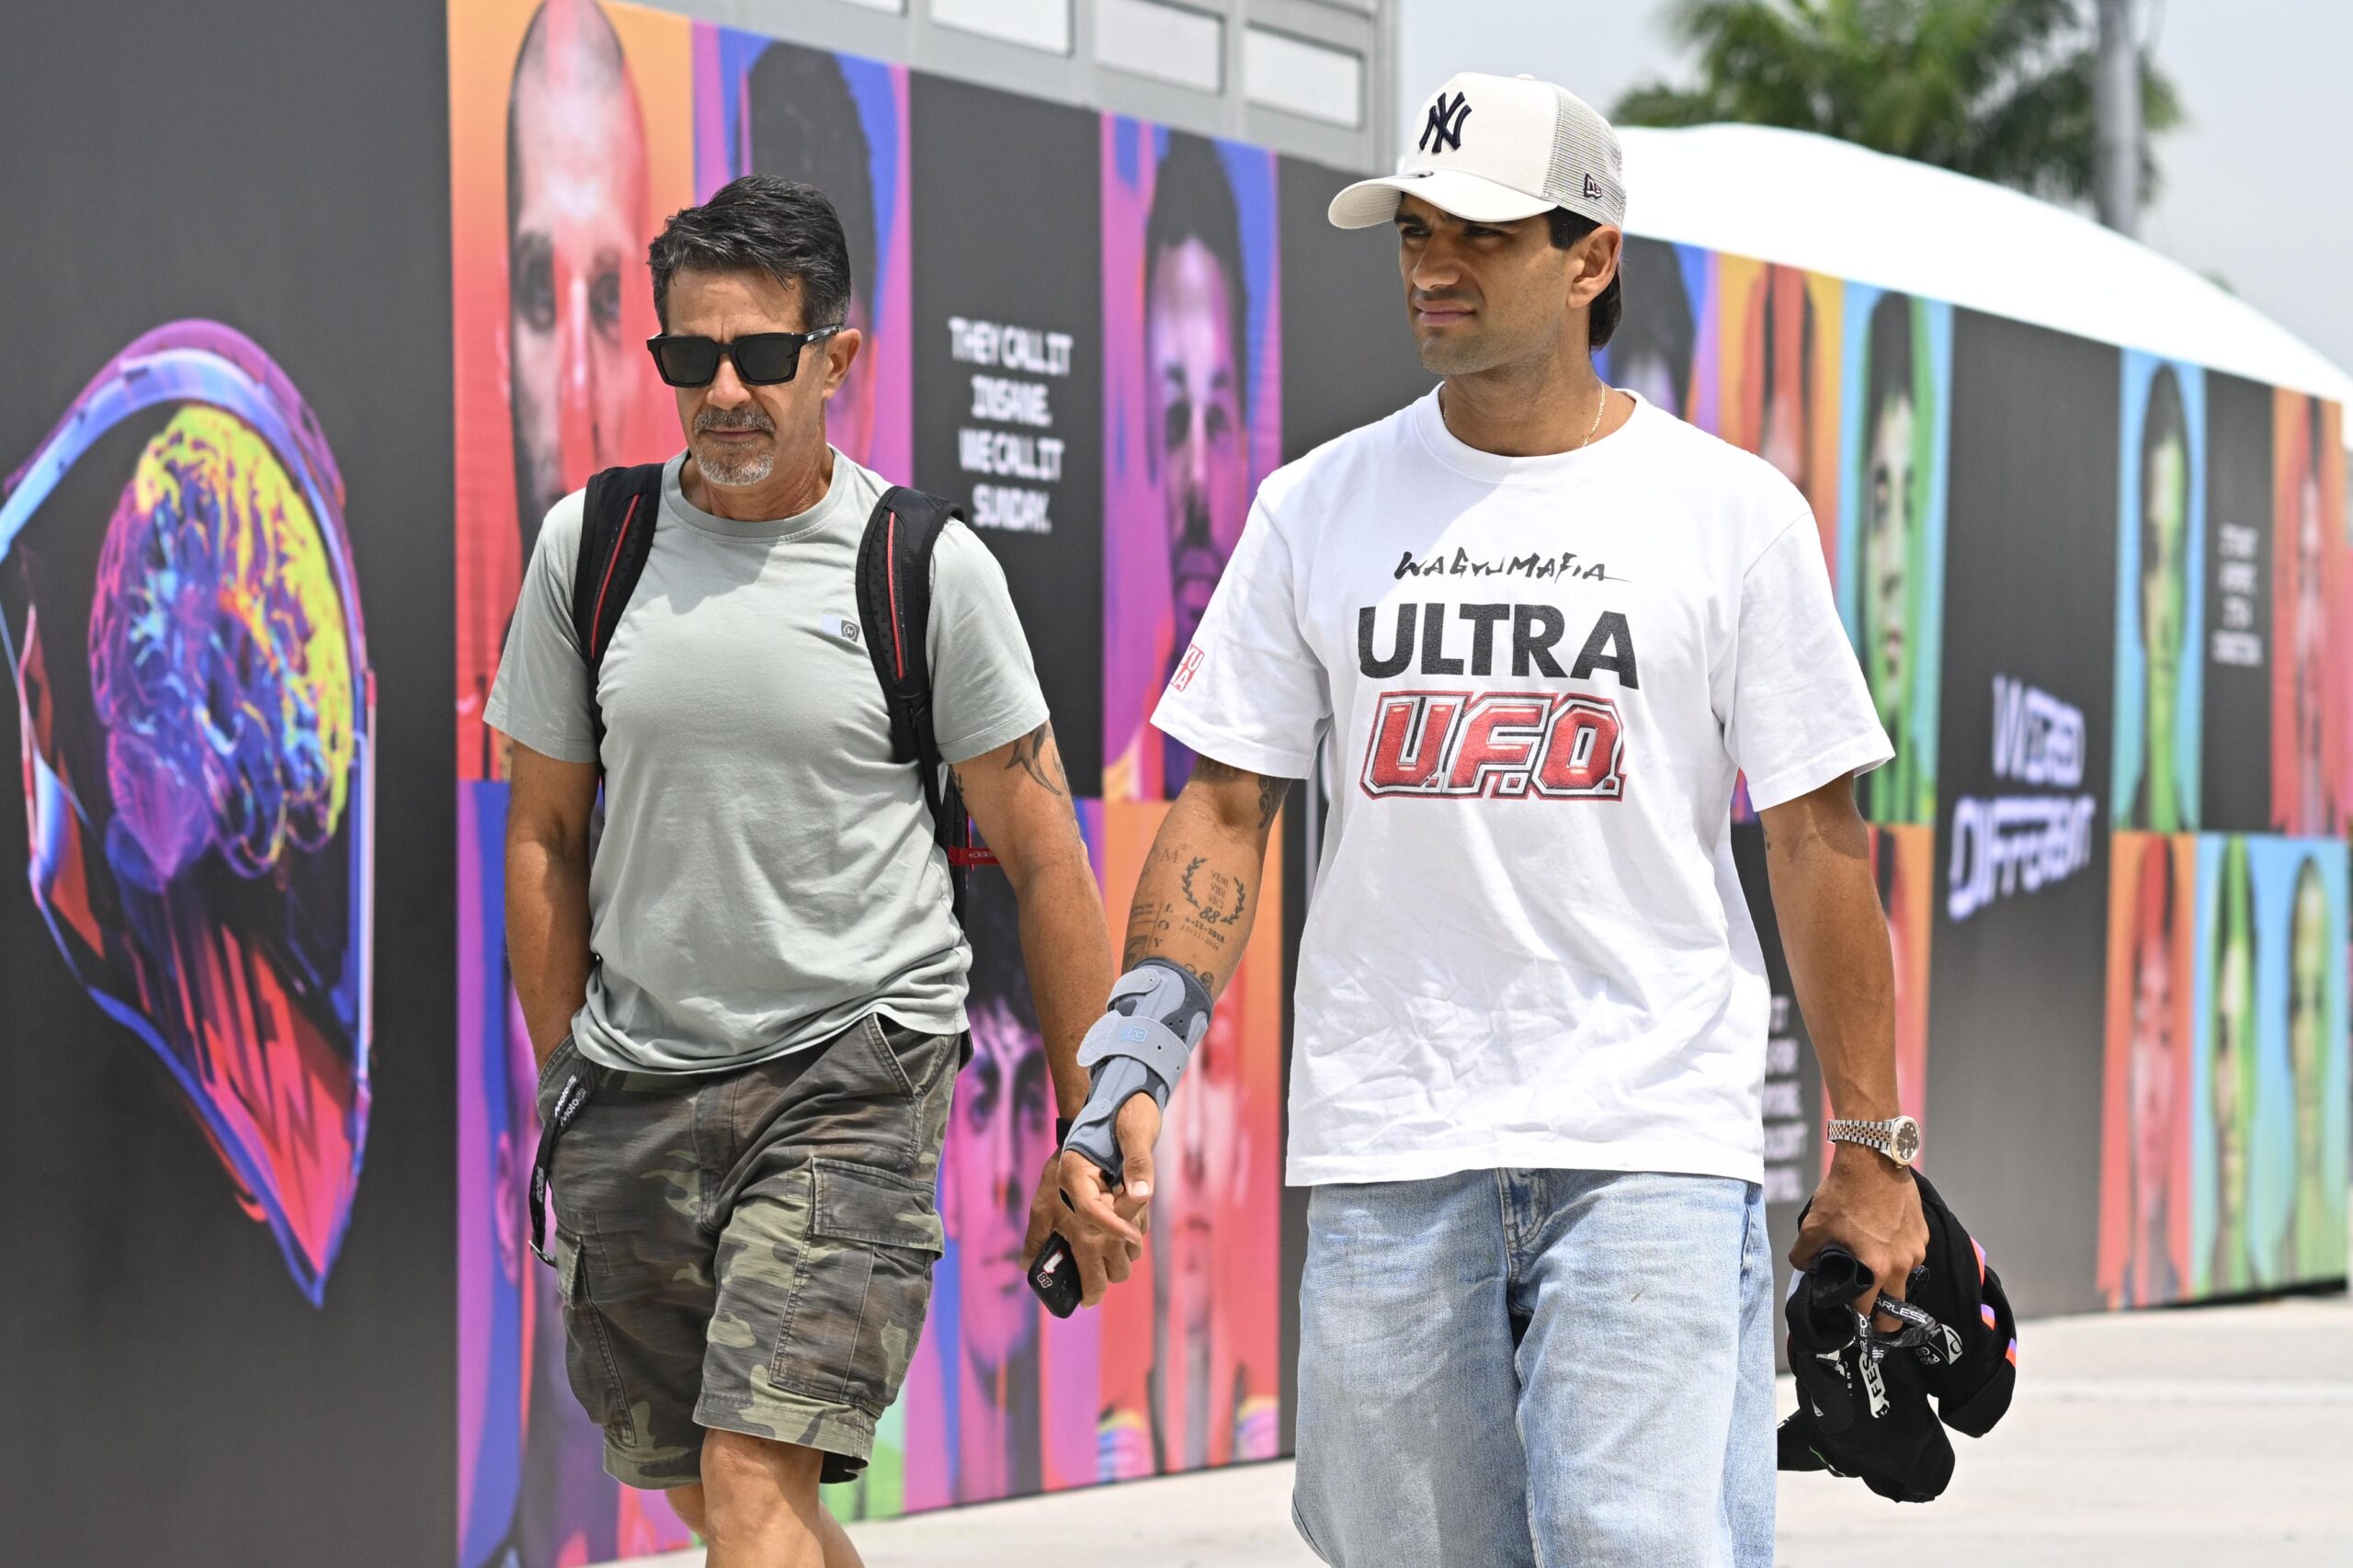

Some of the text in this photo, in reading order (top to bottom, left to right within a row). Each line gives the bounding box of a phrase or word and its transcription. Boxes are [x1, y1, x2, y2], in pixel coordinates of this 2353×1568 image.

[1419, 91, 1472, 153] NY
[1358, 603, 1639, 689] ULTRA
[1875, 1296, 1927, 1324] ARLESS.
